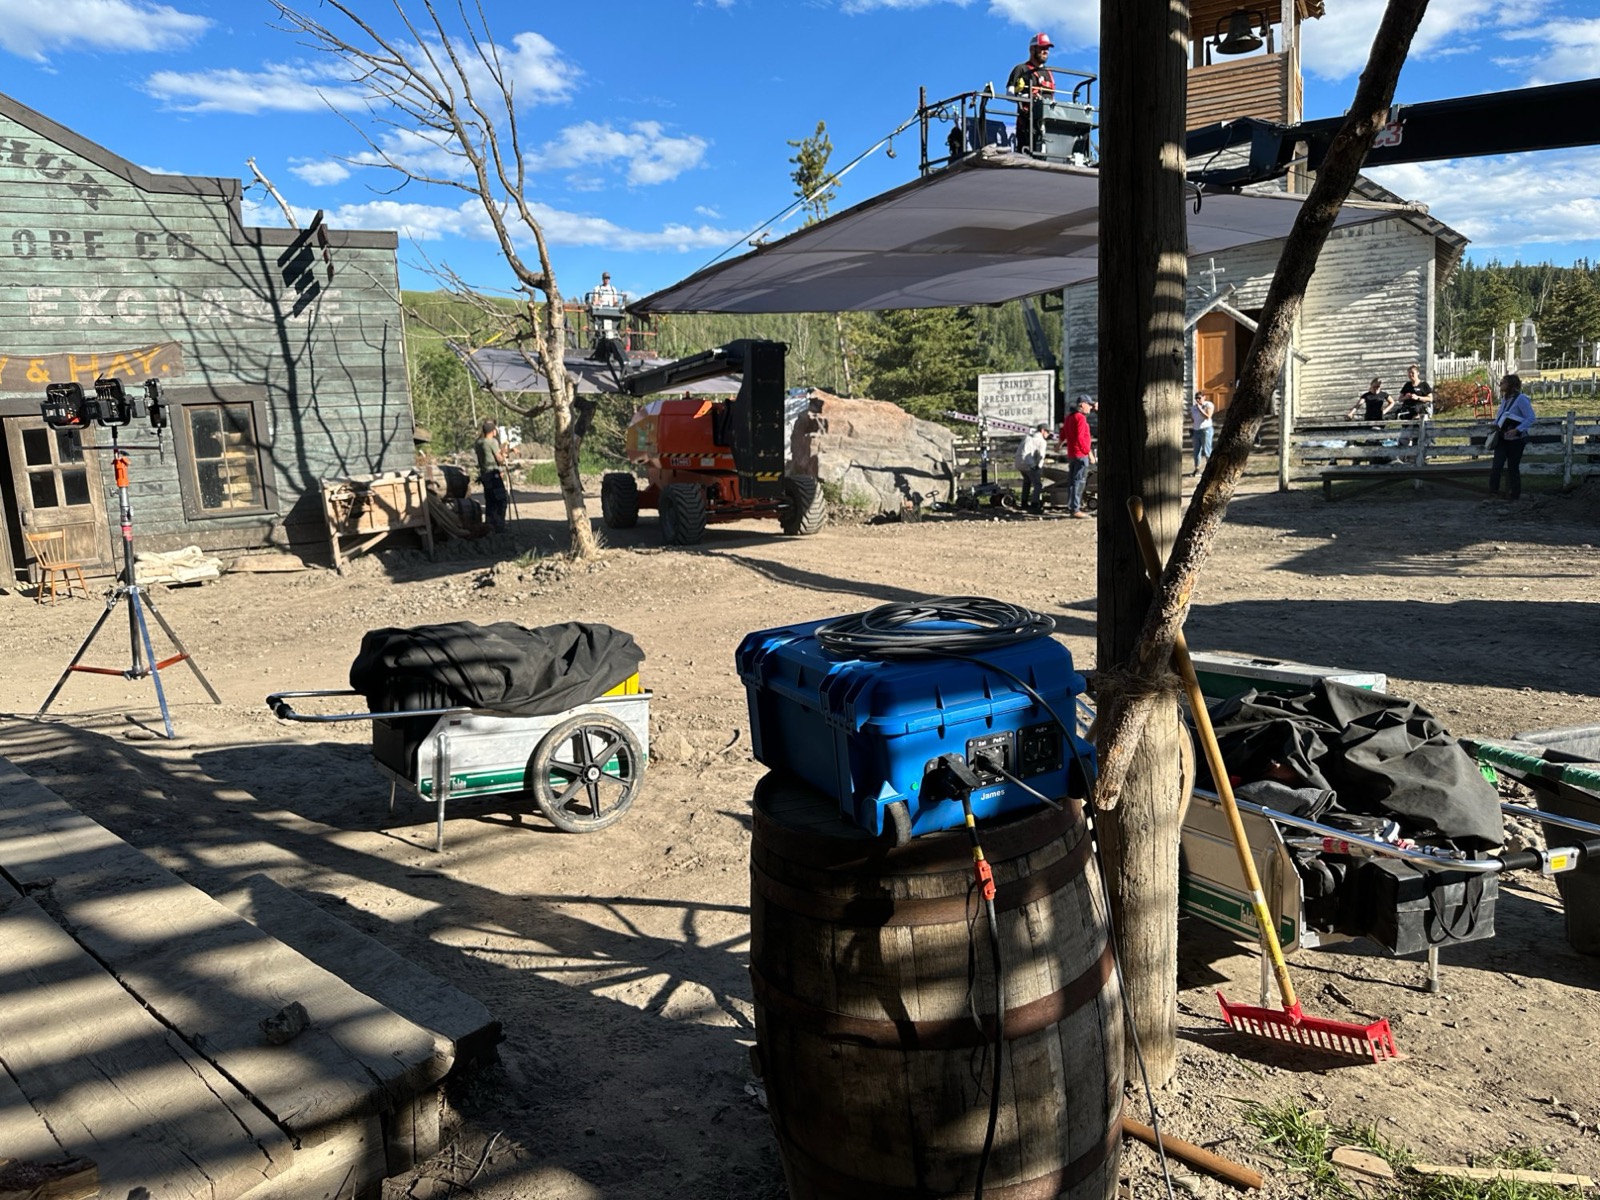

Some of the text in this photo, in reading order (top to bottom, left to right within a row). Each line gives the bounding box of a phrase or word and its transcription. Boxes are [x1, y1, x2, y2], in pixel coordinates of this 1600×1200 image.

[26, 358, 51, 383] &
[998, 380, 1034, 390] TRINITY
[983, 392, 1048, 404] PRESBYTERIAN
[998, 407, 1033, 417] CHURCH
[980, 789, 1005, 801] James
